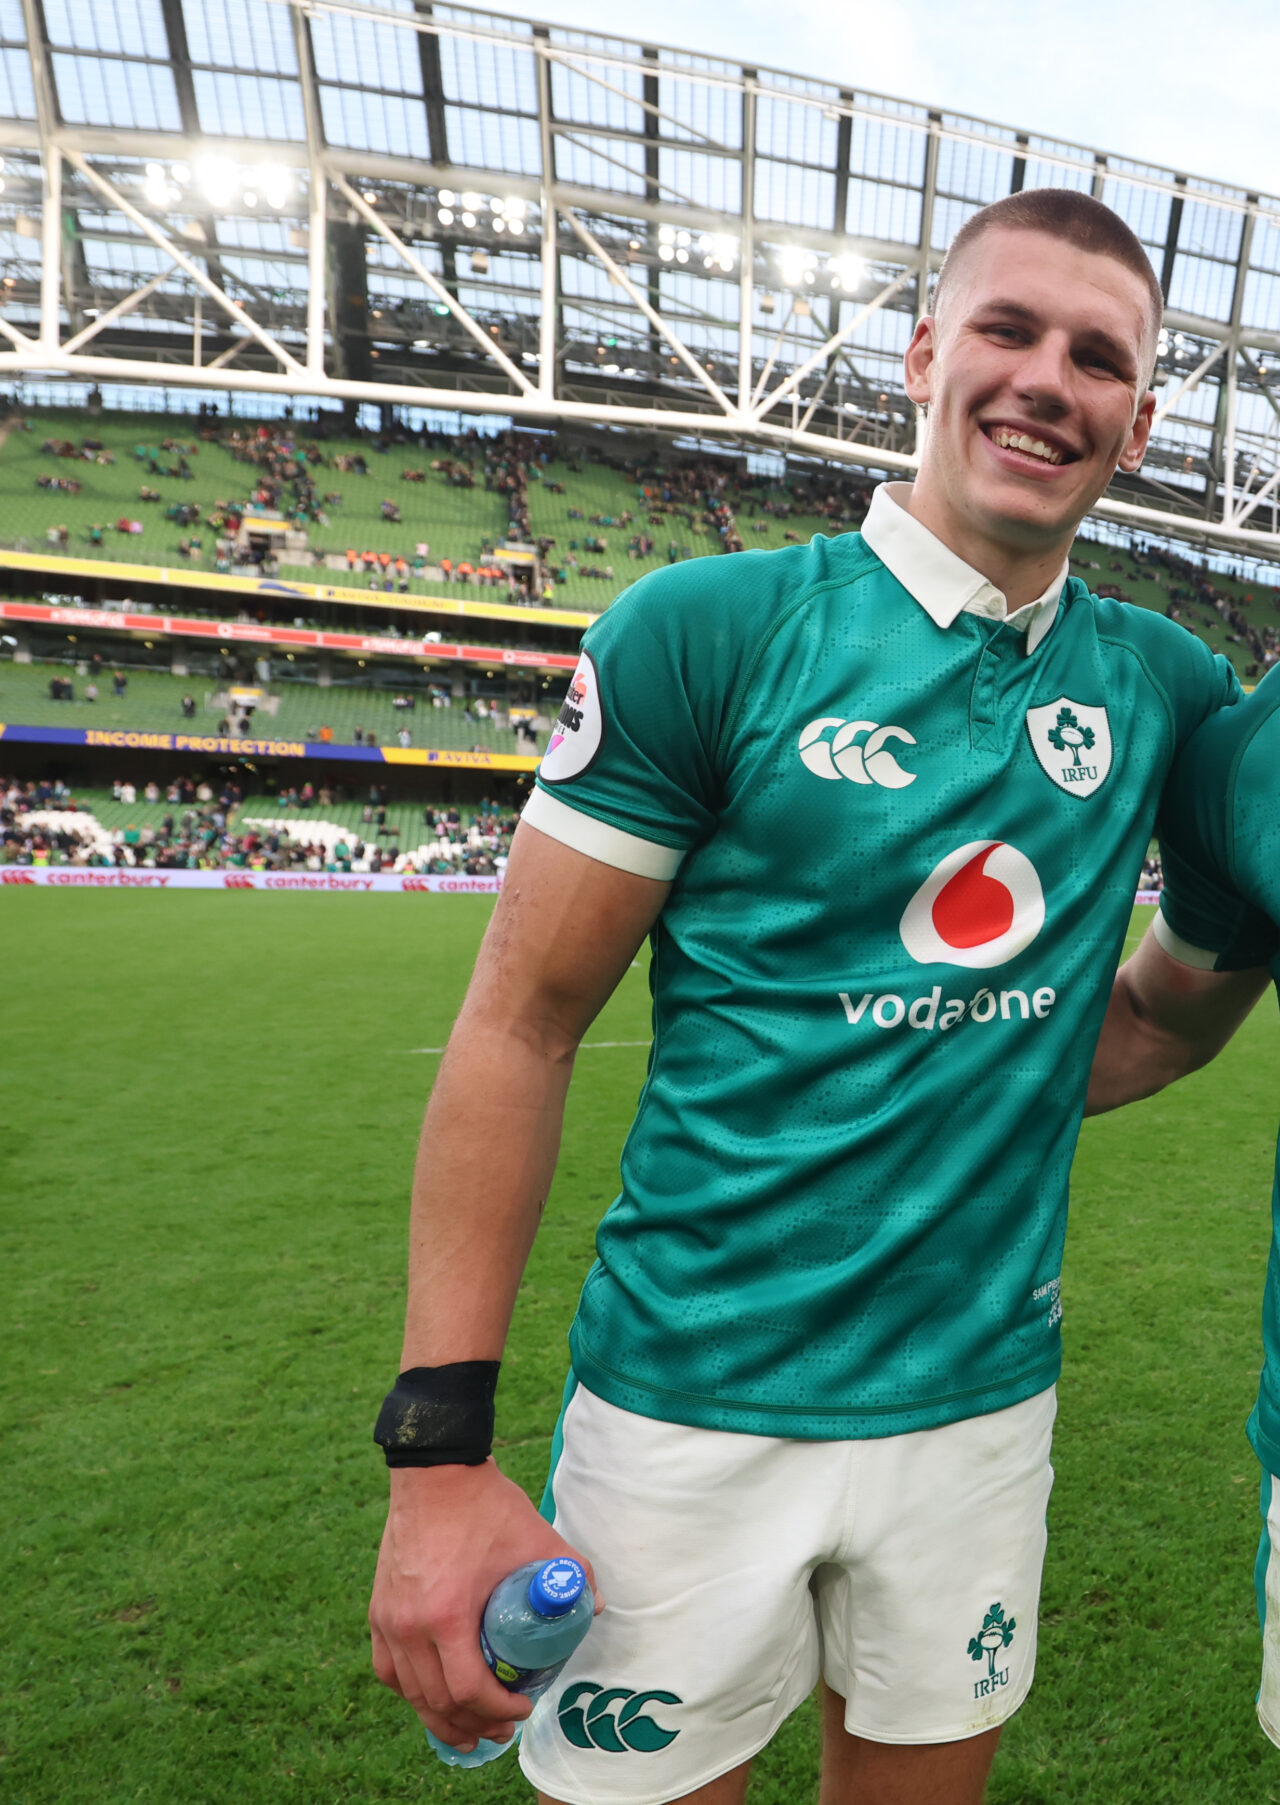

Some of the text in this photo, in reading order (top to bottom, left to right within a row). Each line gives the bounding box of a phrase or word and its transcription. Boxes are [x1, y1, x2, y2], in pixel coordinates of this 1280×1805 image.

[85, 730, 306, 757] INCOME PROTECTION
[443, 753, 491, 763] AVIVA
[1061, 766, 1098, 783] IRFU
[47, 868, 170, 888] canterbury
[265, 874, 374, 890] canterbury
[973, 1666, 1010, 1699] IRFU
